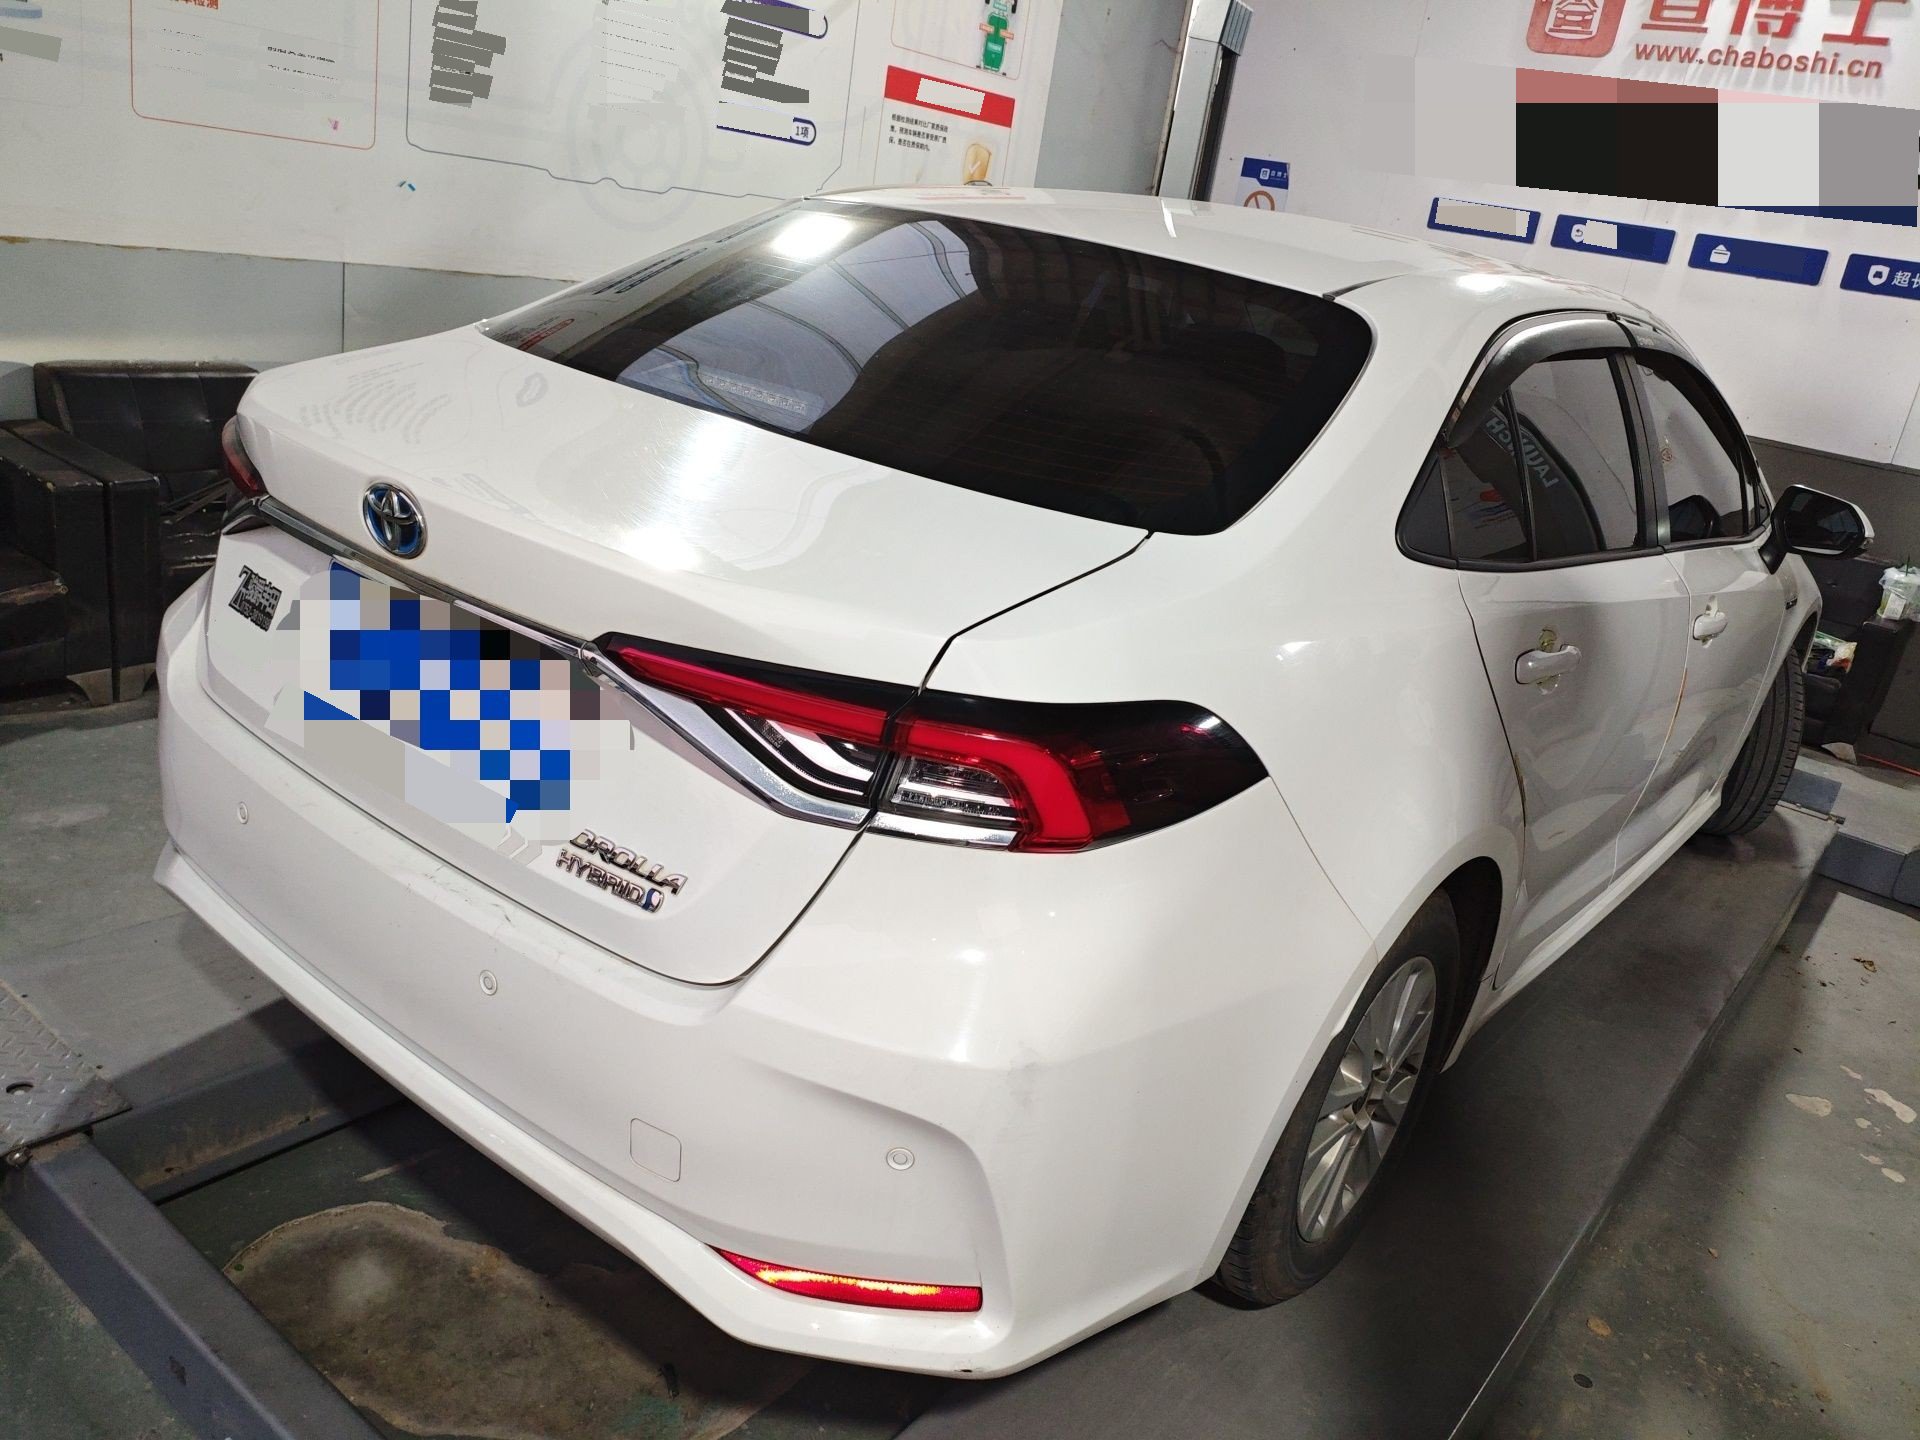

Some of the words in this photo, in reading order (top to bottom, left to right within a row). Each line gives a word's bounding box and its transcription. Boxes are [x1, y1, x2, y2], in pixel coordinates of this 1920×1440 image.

[1635, 43, 1883, 79] www.chaboshi.cn
[556, 848, 646, 905] HYBRID
[570, 828, 689, 896] OROLLA
